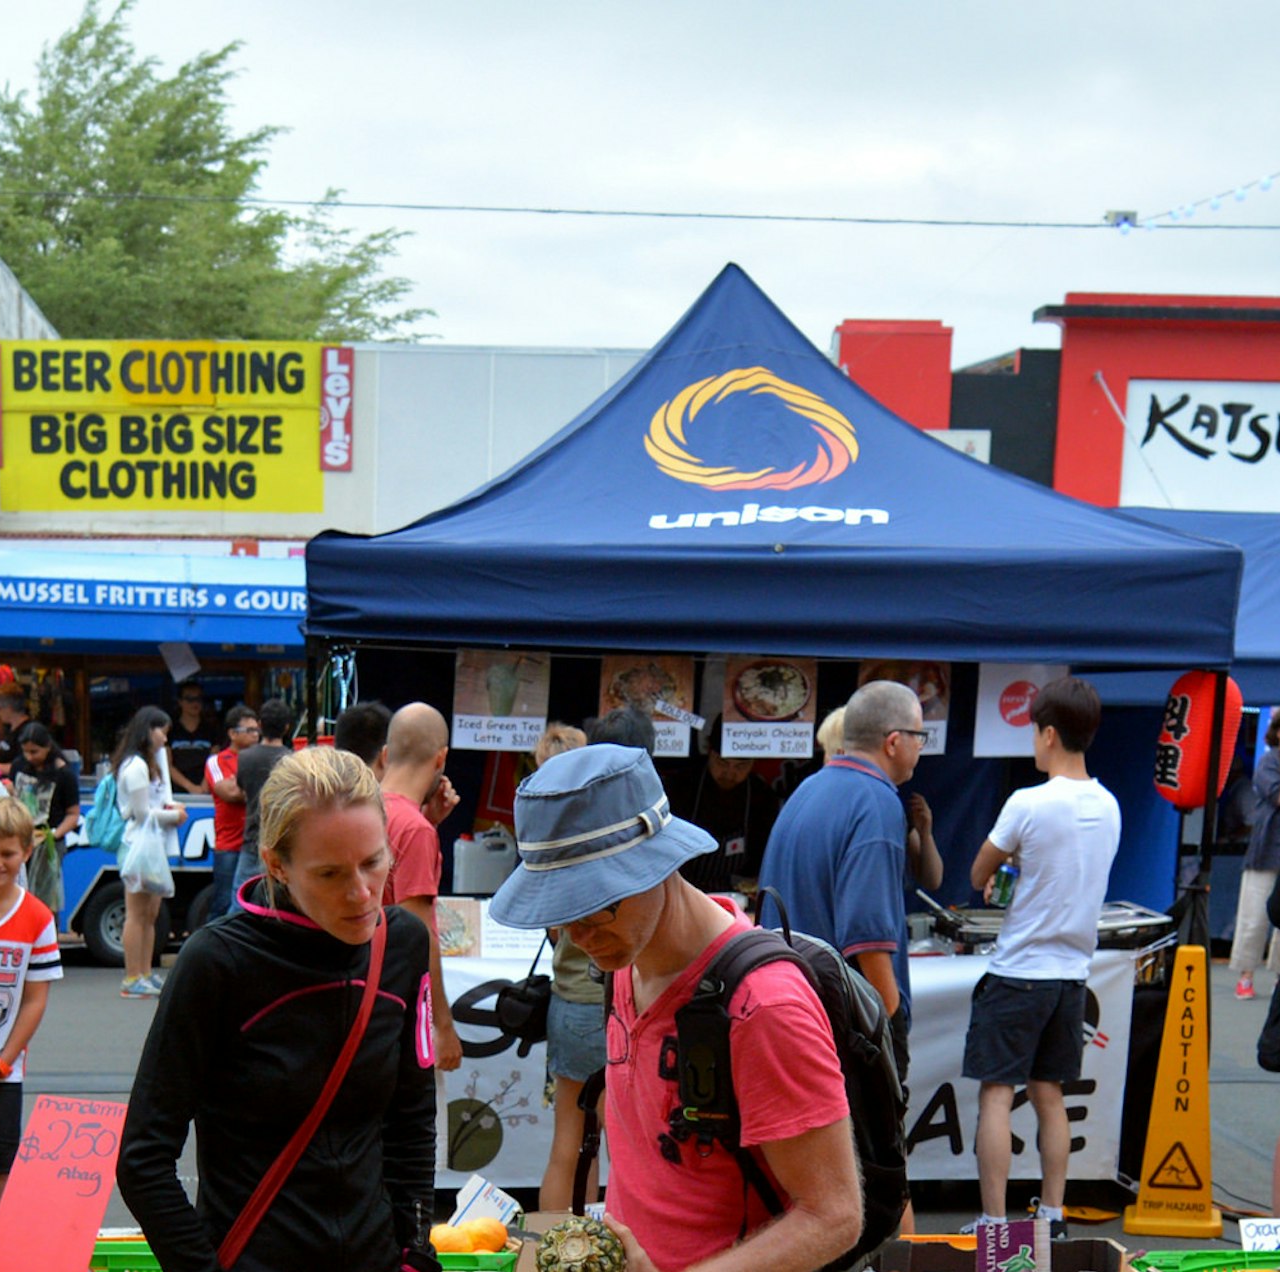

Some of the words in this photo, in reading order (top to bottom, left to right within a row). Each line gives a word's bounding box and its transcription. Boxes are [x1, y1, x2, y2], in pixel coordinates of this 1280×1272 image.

[12, 350, 113, 392] BEER
[120, 351, 307, 395] CLOTHING
[202, 416, 283, 455] SIZE
[60, 461, 257, 499] CLOTHING
[649, 502, 889, 530] unison
[95, 585, 209, 608] FRITTERS
[234, 588, 307, 611] GOUR
[458, 719, 482, 730] Iced
[487, 720, 517, 732] Green
[522, 721, 541, 732] Tea
[661, 703, 681, 718] SOLD
[683, 711, 702, 725] OUT
[474, 733, 502, 744] Latte
[726, 728, 767, 740] Teriyaki
[772, 728, 810, 739] Chicken
[732, 741, 769, 751] Donburi
[1175, 988, 1195, 1112] CAUTION
[1144, 1201, 1164, 1212] TRIP
[1166, 1203, 1205, 1214] HAZARD
